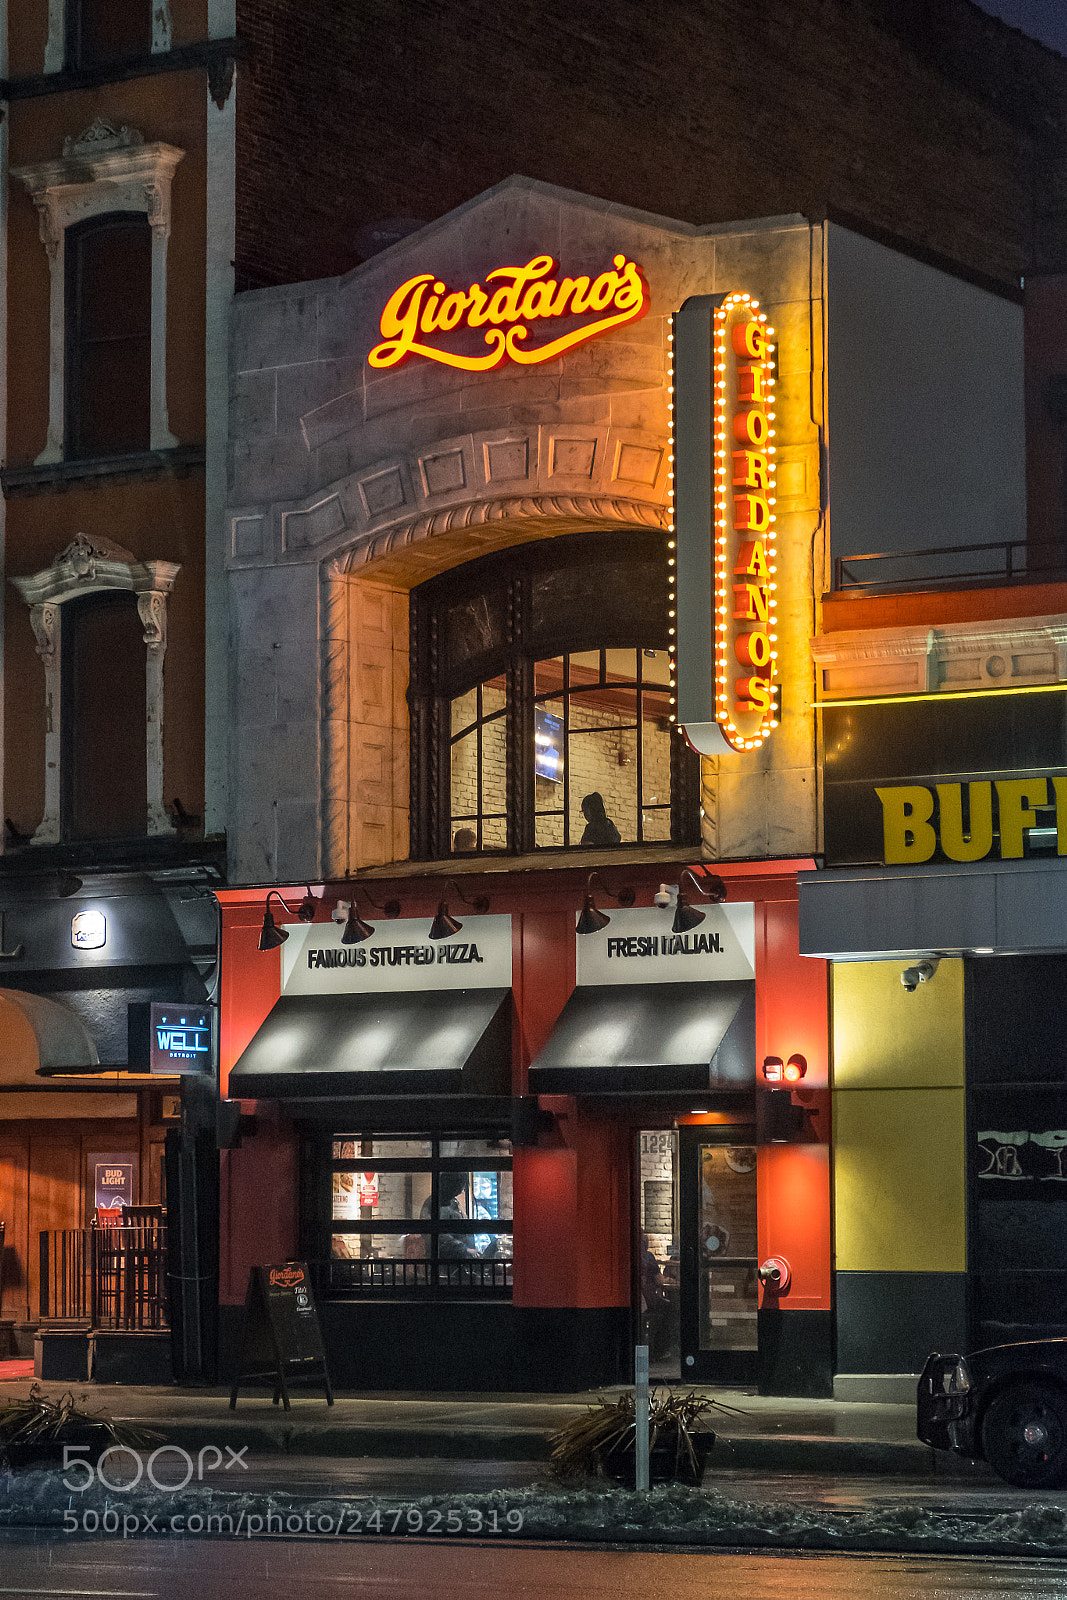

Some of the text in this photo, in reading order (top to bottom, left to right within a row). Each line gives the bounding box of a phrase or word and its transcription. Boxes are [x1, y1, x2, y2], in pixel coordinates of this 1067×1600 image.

[367, 254, 643, 371] Giordano's
[307, 943, 484, 969] FAMOUS STUFFED PIZZA.
[607, 933, 724, 958] FRESH ITALIAN.
[156, 1031, 209, 1052] WELL
[101, 1177, 126, 1185] LIGHT
[105, 1169, 123, 1178] BUD
